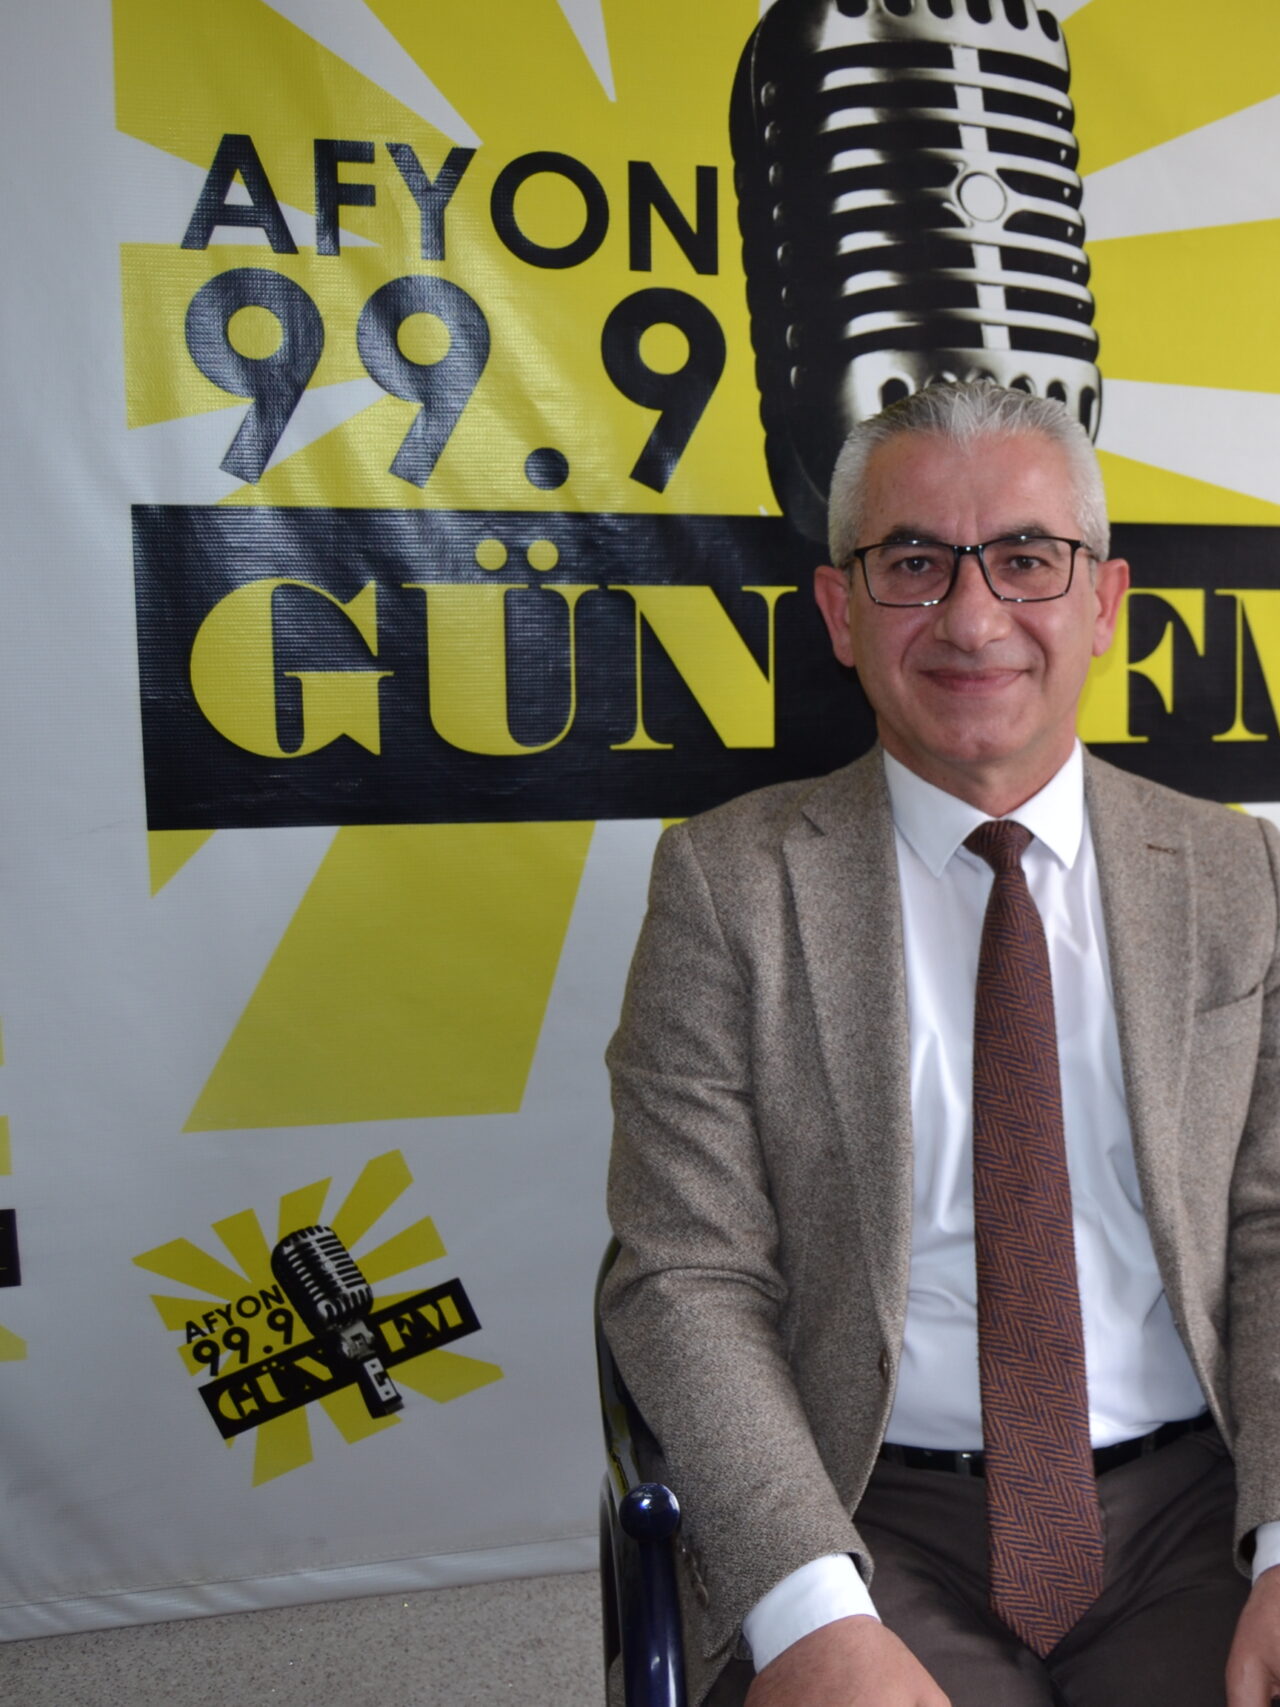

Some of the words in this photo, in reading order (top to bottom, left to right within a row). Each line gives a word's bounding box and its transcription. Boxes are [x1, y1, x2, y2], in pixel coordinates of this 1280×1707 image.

[180, 133, 719, 276] AFYON
[185, 267, 726, 494] 99.9
[190, 539, 798, 758] GÜN
[185, 1285, 285, 1344] AFYON
[192, 1308, 294, 1377] 99.9
[218, 1355, 333, 1421] GÜN
[379, 1295, 464, 1353] FM
